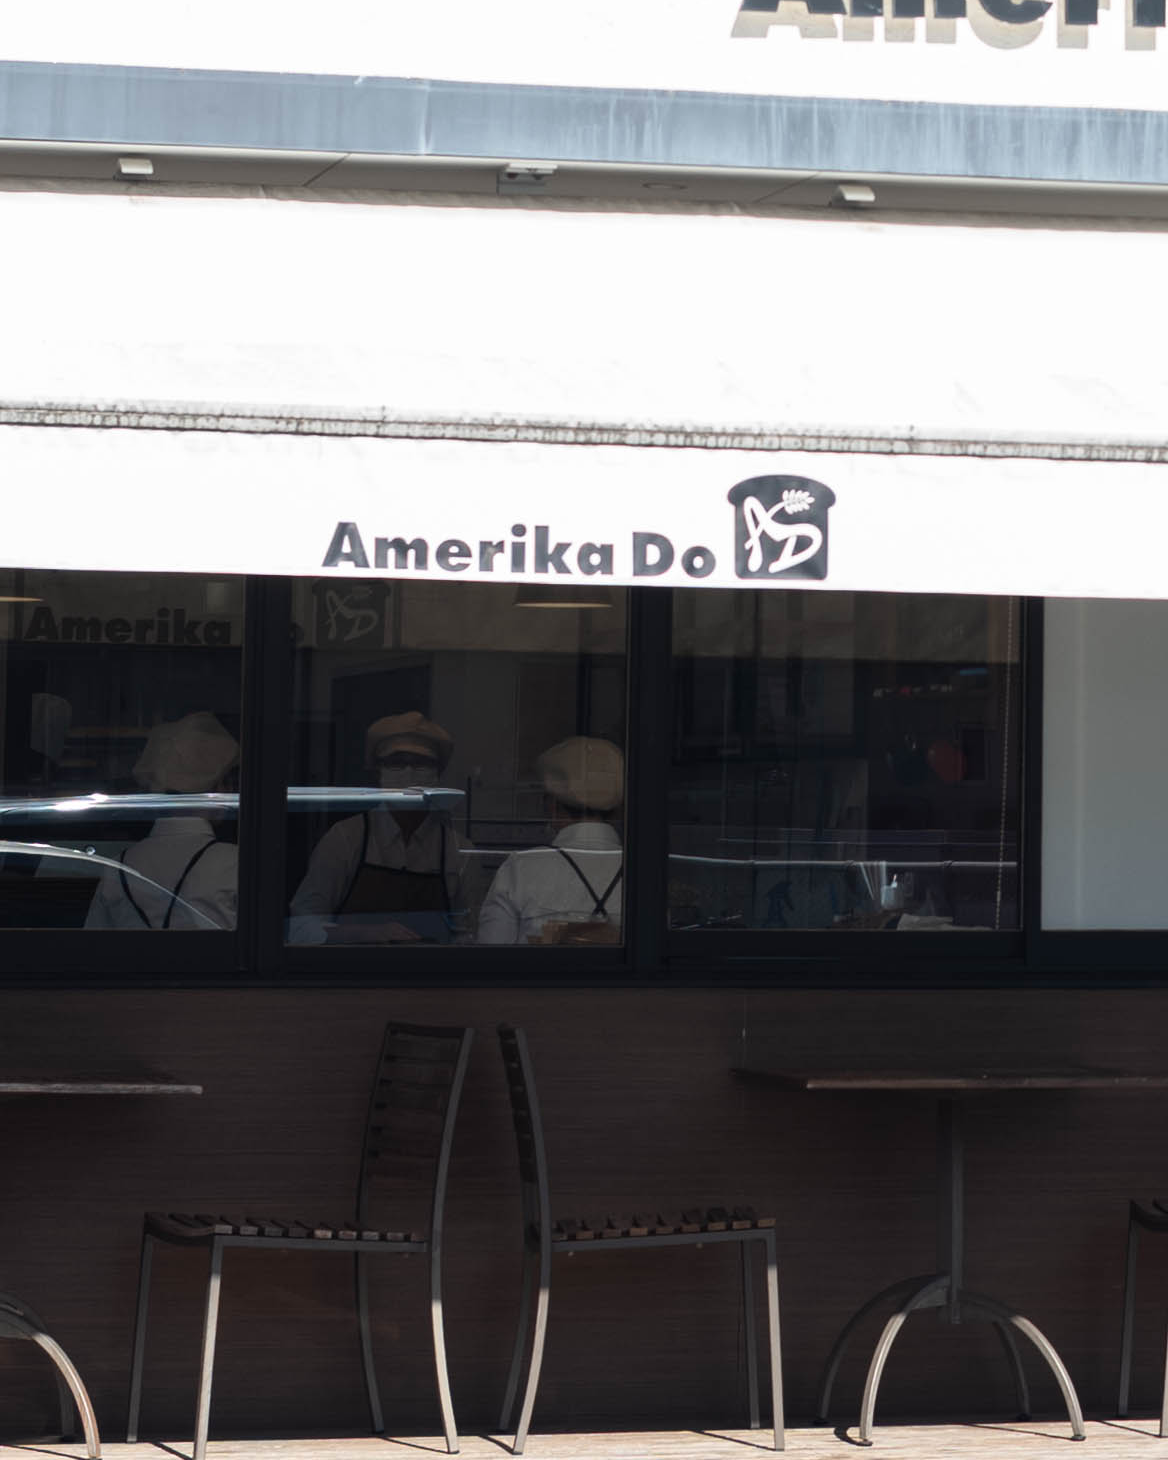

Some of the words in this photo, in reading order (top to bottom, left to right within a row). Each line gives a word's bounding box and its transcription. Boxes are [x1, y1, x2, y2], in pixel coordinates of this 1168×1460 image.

[321, 521, 614, 576] Amerika
[632, 531, 716, 579] Do
[24, 606, 232, 646] Amerika
